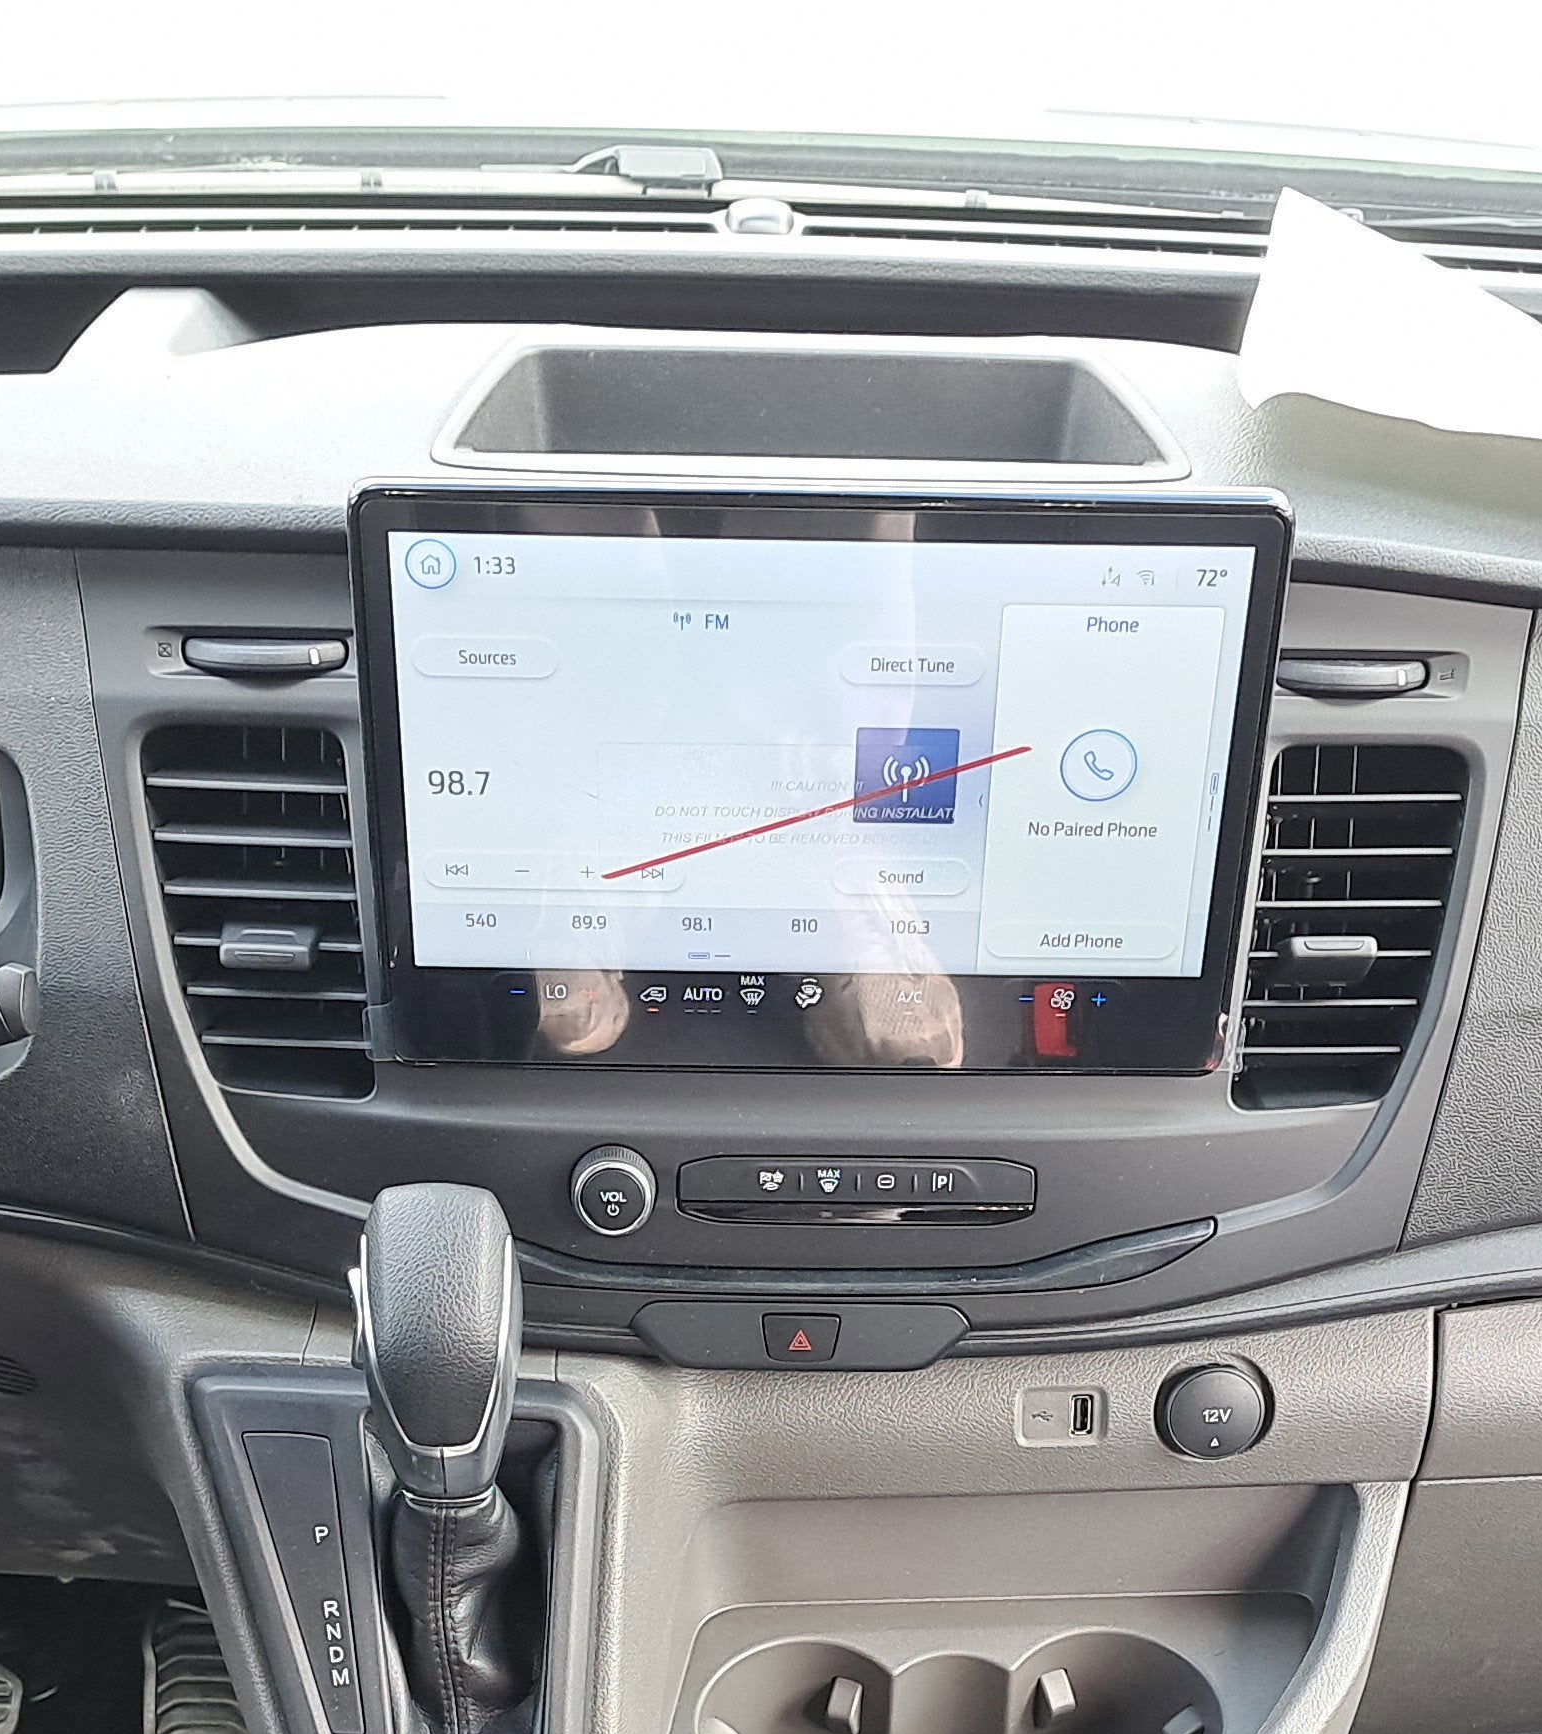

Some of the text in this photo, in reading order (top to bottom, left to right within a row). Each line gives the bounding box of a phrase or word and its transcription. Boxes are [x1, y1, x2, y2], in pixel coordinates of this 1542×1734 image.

[473, 555, 517, 576] 1:33
[1196, 568, 1228, 588] 72°
[705, 614, 730, 630] FM
[1086, 616, 1140, 635] Phone
[458, 649, 517, 666] Sources
[871, 657, 955, 674] Direct Tune
[427, 770, 491, 796] 98.7
[785, 780, 847, 792] CAUTION
[654, 805, 676, 818] DO
[679, 806, 709, 818] NOT
[712, 806, 761, 818] TOUCH
[662, 832, 692, 844] THIS
[1028, 822, 1158, 839] No Paired Phone
[878, 869, 924, 885] Sound
[465, 912, 497, 929] 540
[572, 914, 608, 930] 89.9
[682, 916, 713, 932] 98.1
[791, 917, 819, 933] 810
[889, 918, 930, 935] 106.3
[1039, 933, 1124, 949] Add Phone
[740, 975, 765, 987] MAX
[545, 984, 567, 999] LO
[683, 987, 723, 1002] AUTO
[896, 989, 923, 1005] A/C
[817, 1169, 841, 1179] MAX
[599, 1191, 627, 1203] VOL
[1202, 1408, 1232, 1423] 12V
[314, 1526, 329, 1543] P
[323, 1600, 340, 1619] R
[325, 1622, 342, 1641] N
[328, 1646, 344, 1663] D
[331, 1667, 350, 1687] M
